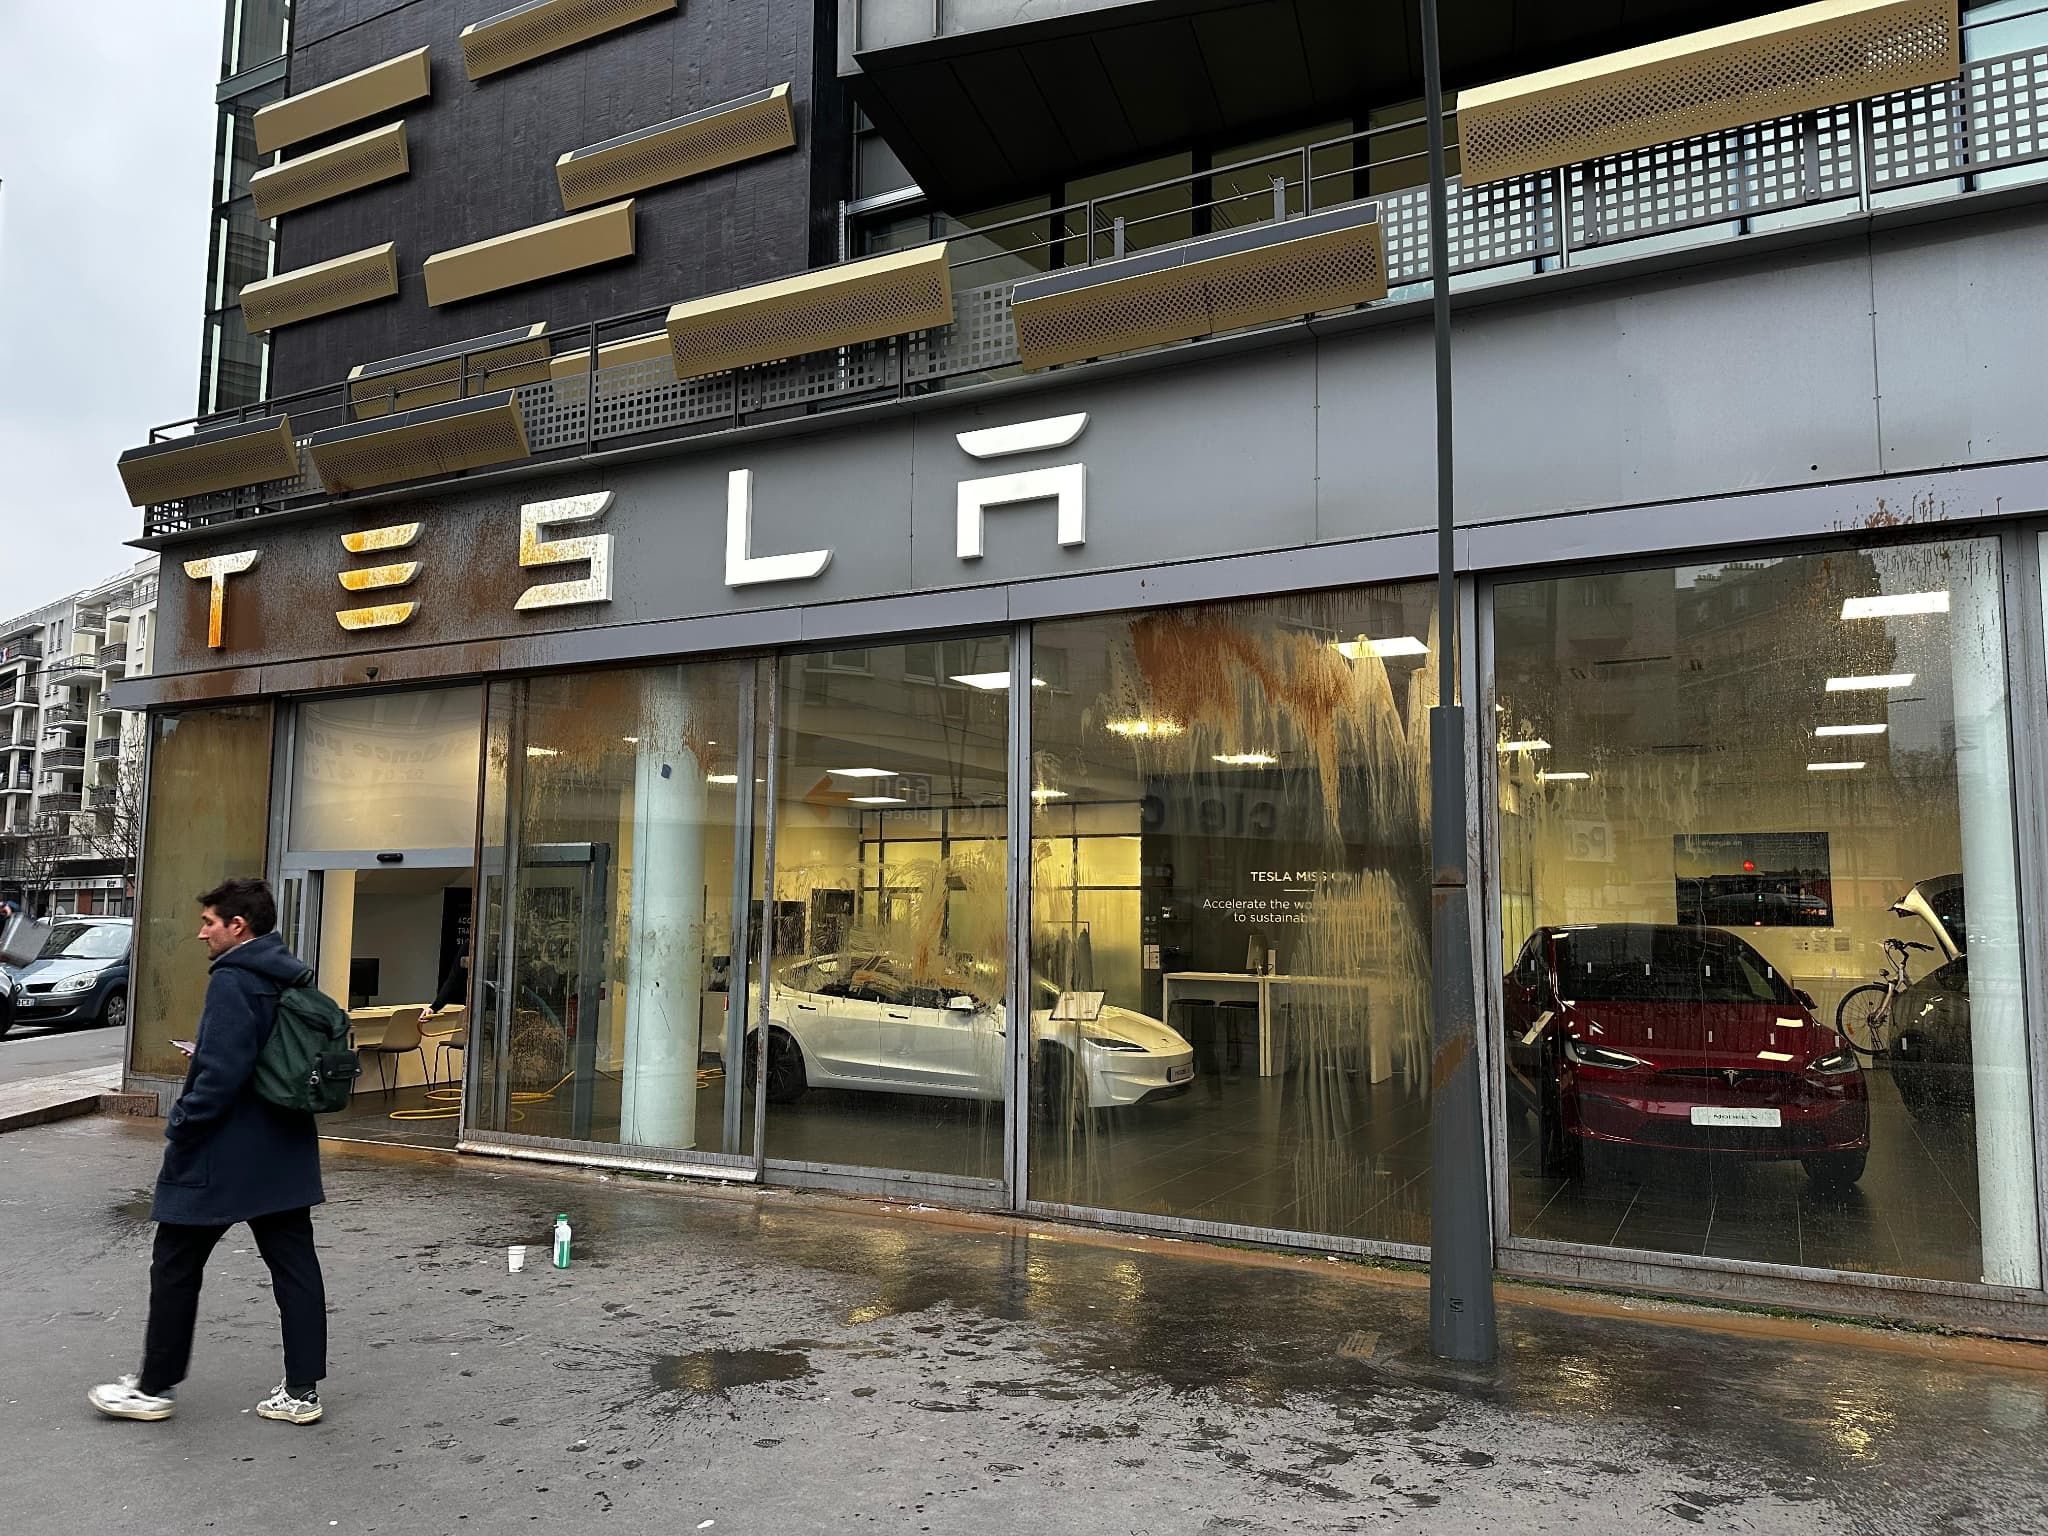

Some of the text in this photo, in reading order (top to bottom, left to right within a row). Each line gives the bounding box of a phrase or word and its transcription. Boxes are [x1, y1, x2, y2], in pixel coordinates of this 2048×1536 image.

[183, 412, 1089, 649] TESLA
[1250, 871, 1293, 882] TESLA
[1203, 898, 1267, 909] Accelerate
[1270, 898, 1290, 909] the
[1234, 912, 1247, 923] to
